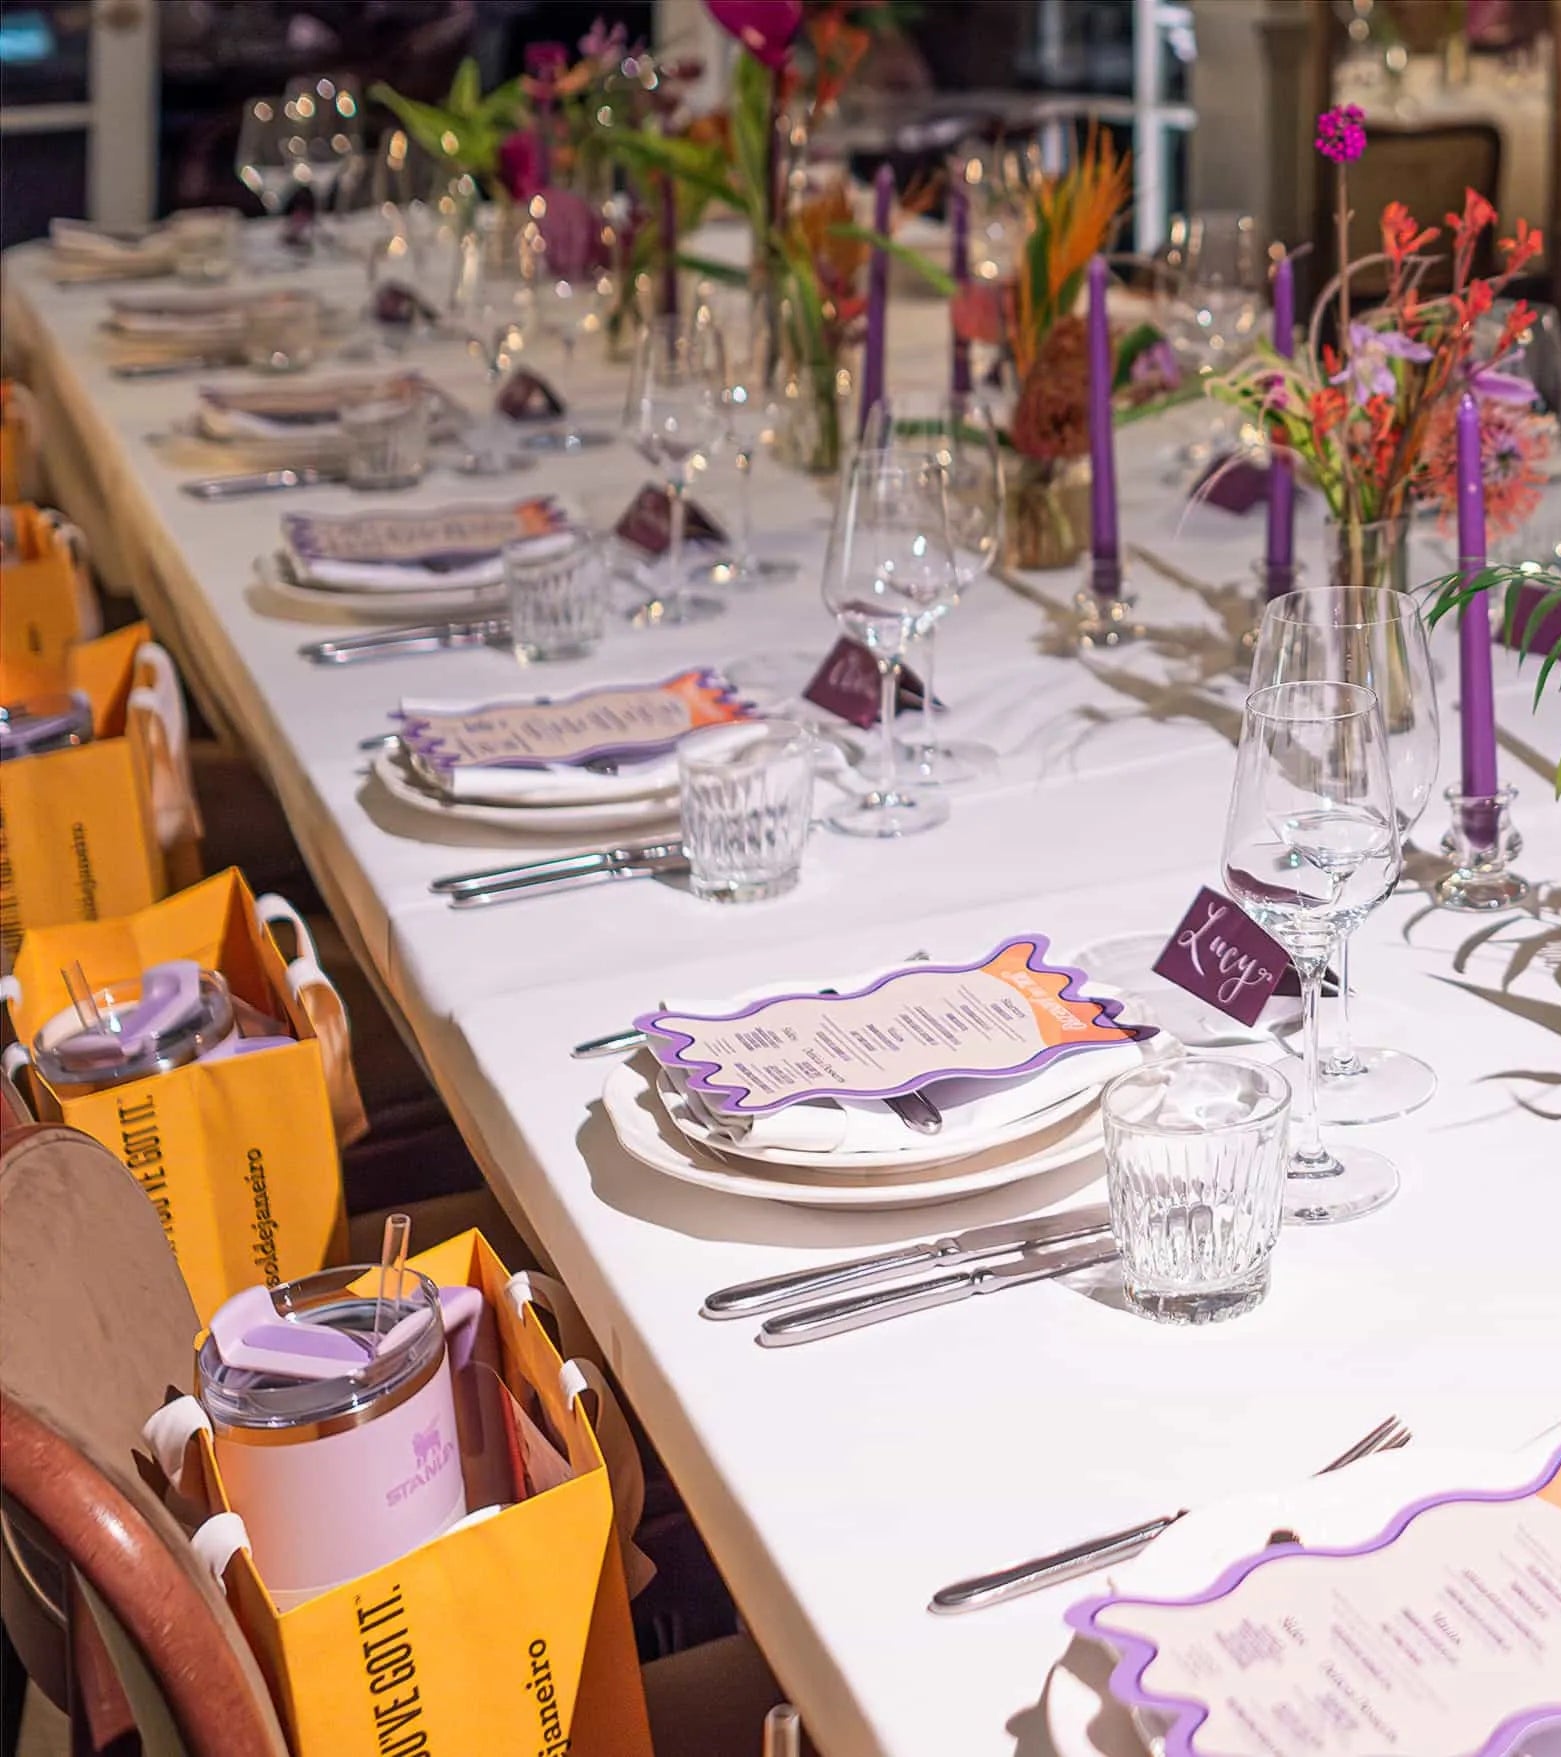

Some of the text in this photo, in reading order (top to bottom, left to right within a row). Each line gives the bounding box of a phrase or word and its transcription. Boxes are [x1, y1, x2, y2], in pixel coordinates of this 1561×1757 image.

[1177, 901, 1273, 1004] Lucy
[121, 1126, 163, 1170] GOT
[362, 1626, 416, 1695] GOT
